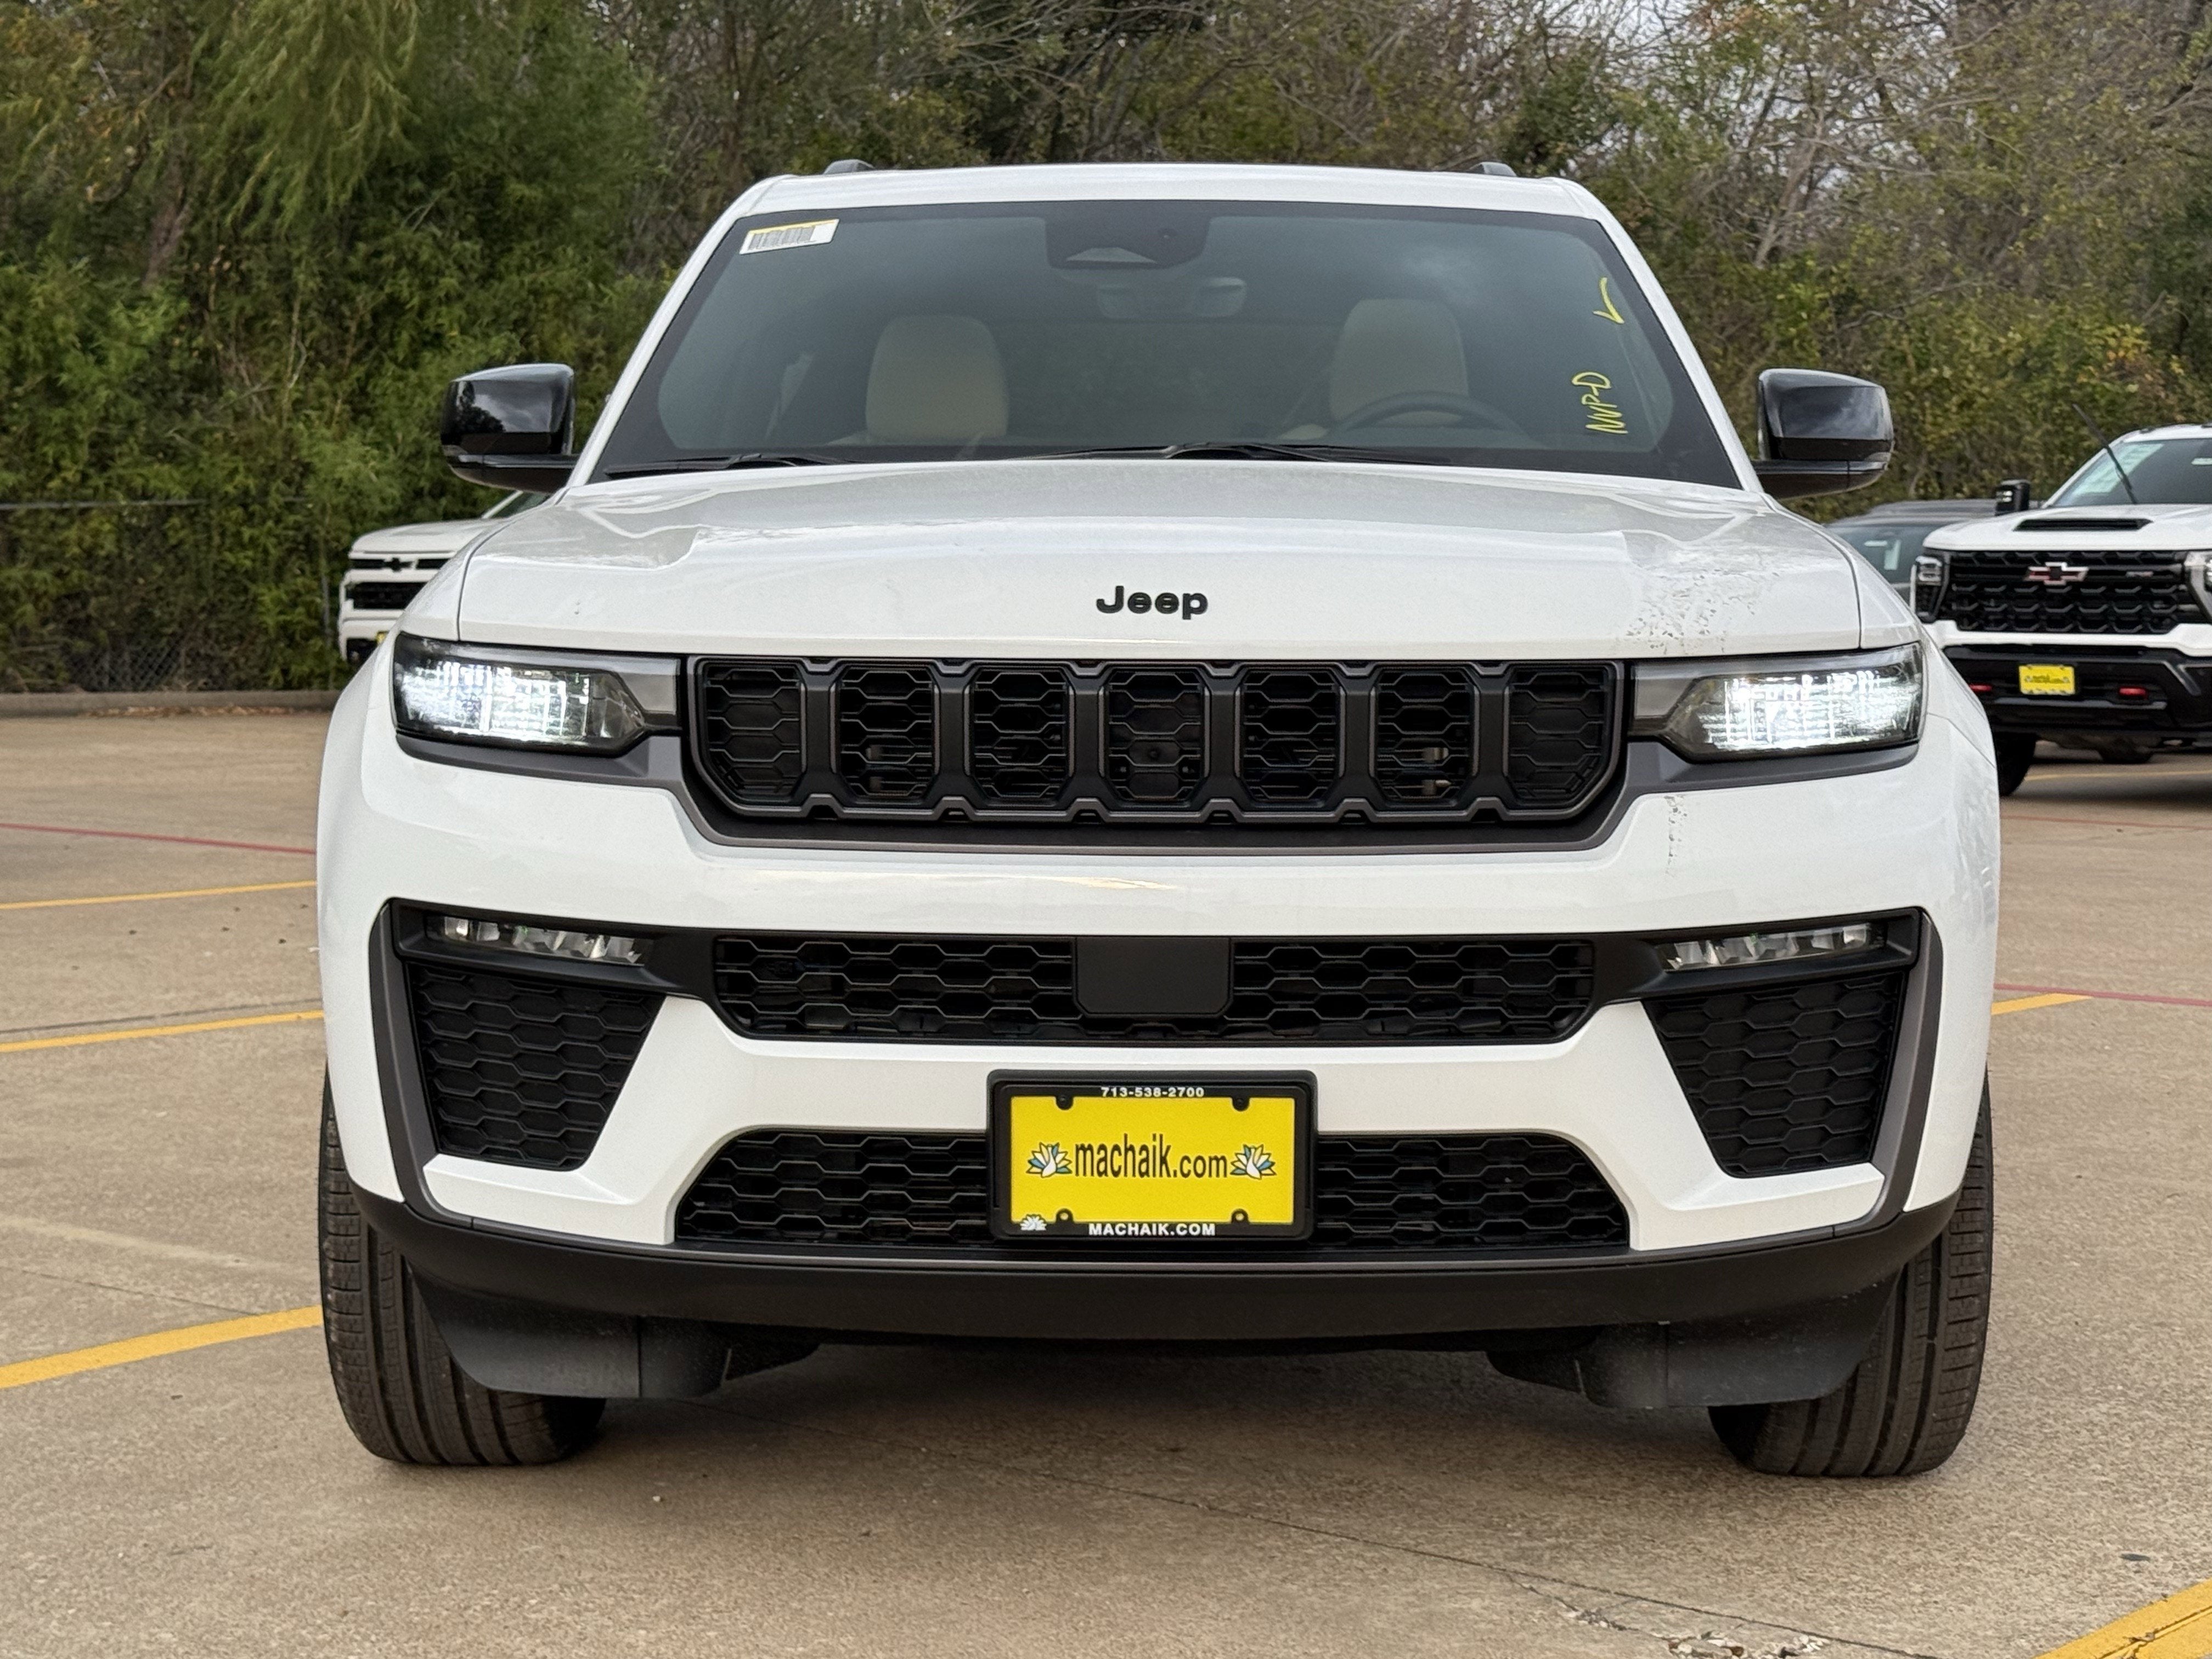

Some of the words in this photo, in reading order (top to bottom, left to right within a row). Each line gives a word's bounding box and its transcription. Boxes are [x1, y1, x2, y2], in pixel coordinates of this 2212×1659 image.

[1096, 585, 1208, 620] Jeep
[1101, 1087, 1205, 1097] 713-538-2700
[1075, 1133, 1228, 1178] machaik.com
[1088, 1223, 1216, 1235] MACHAIK.COM
